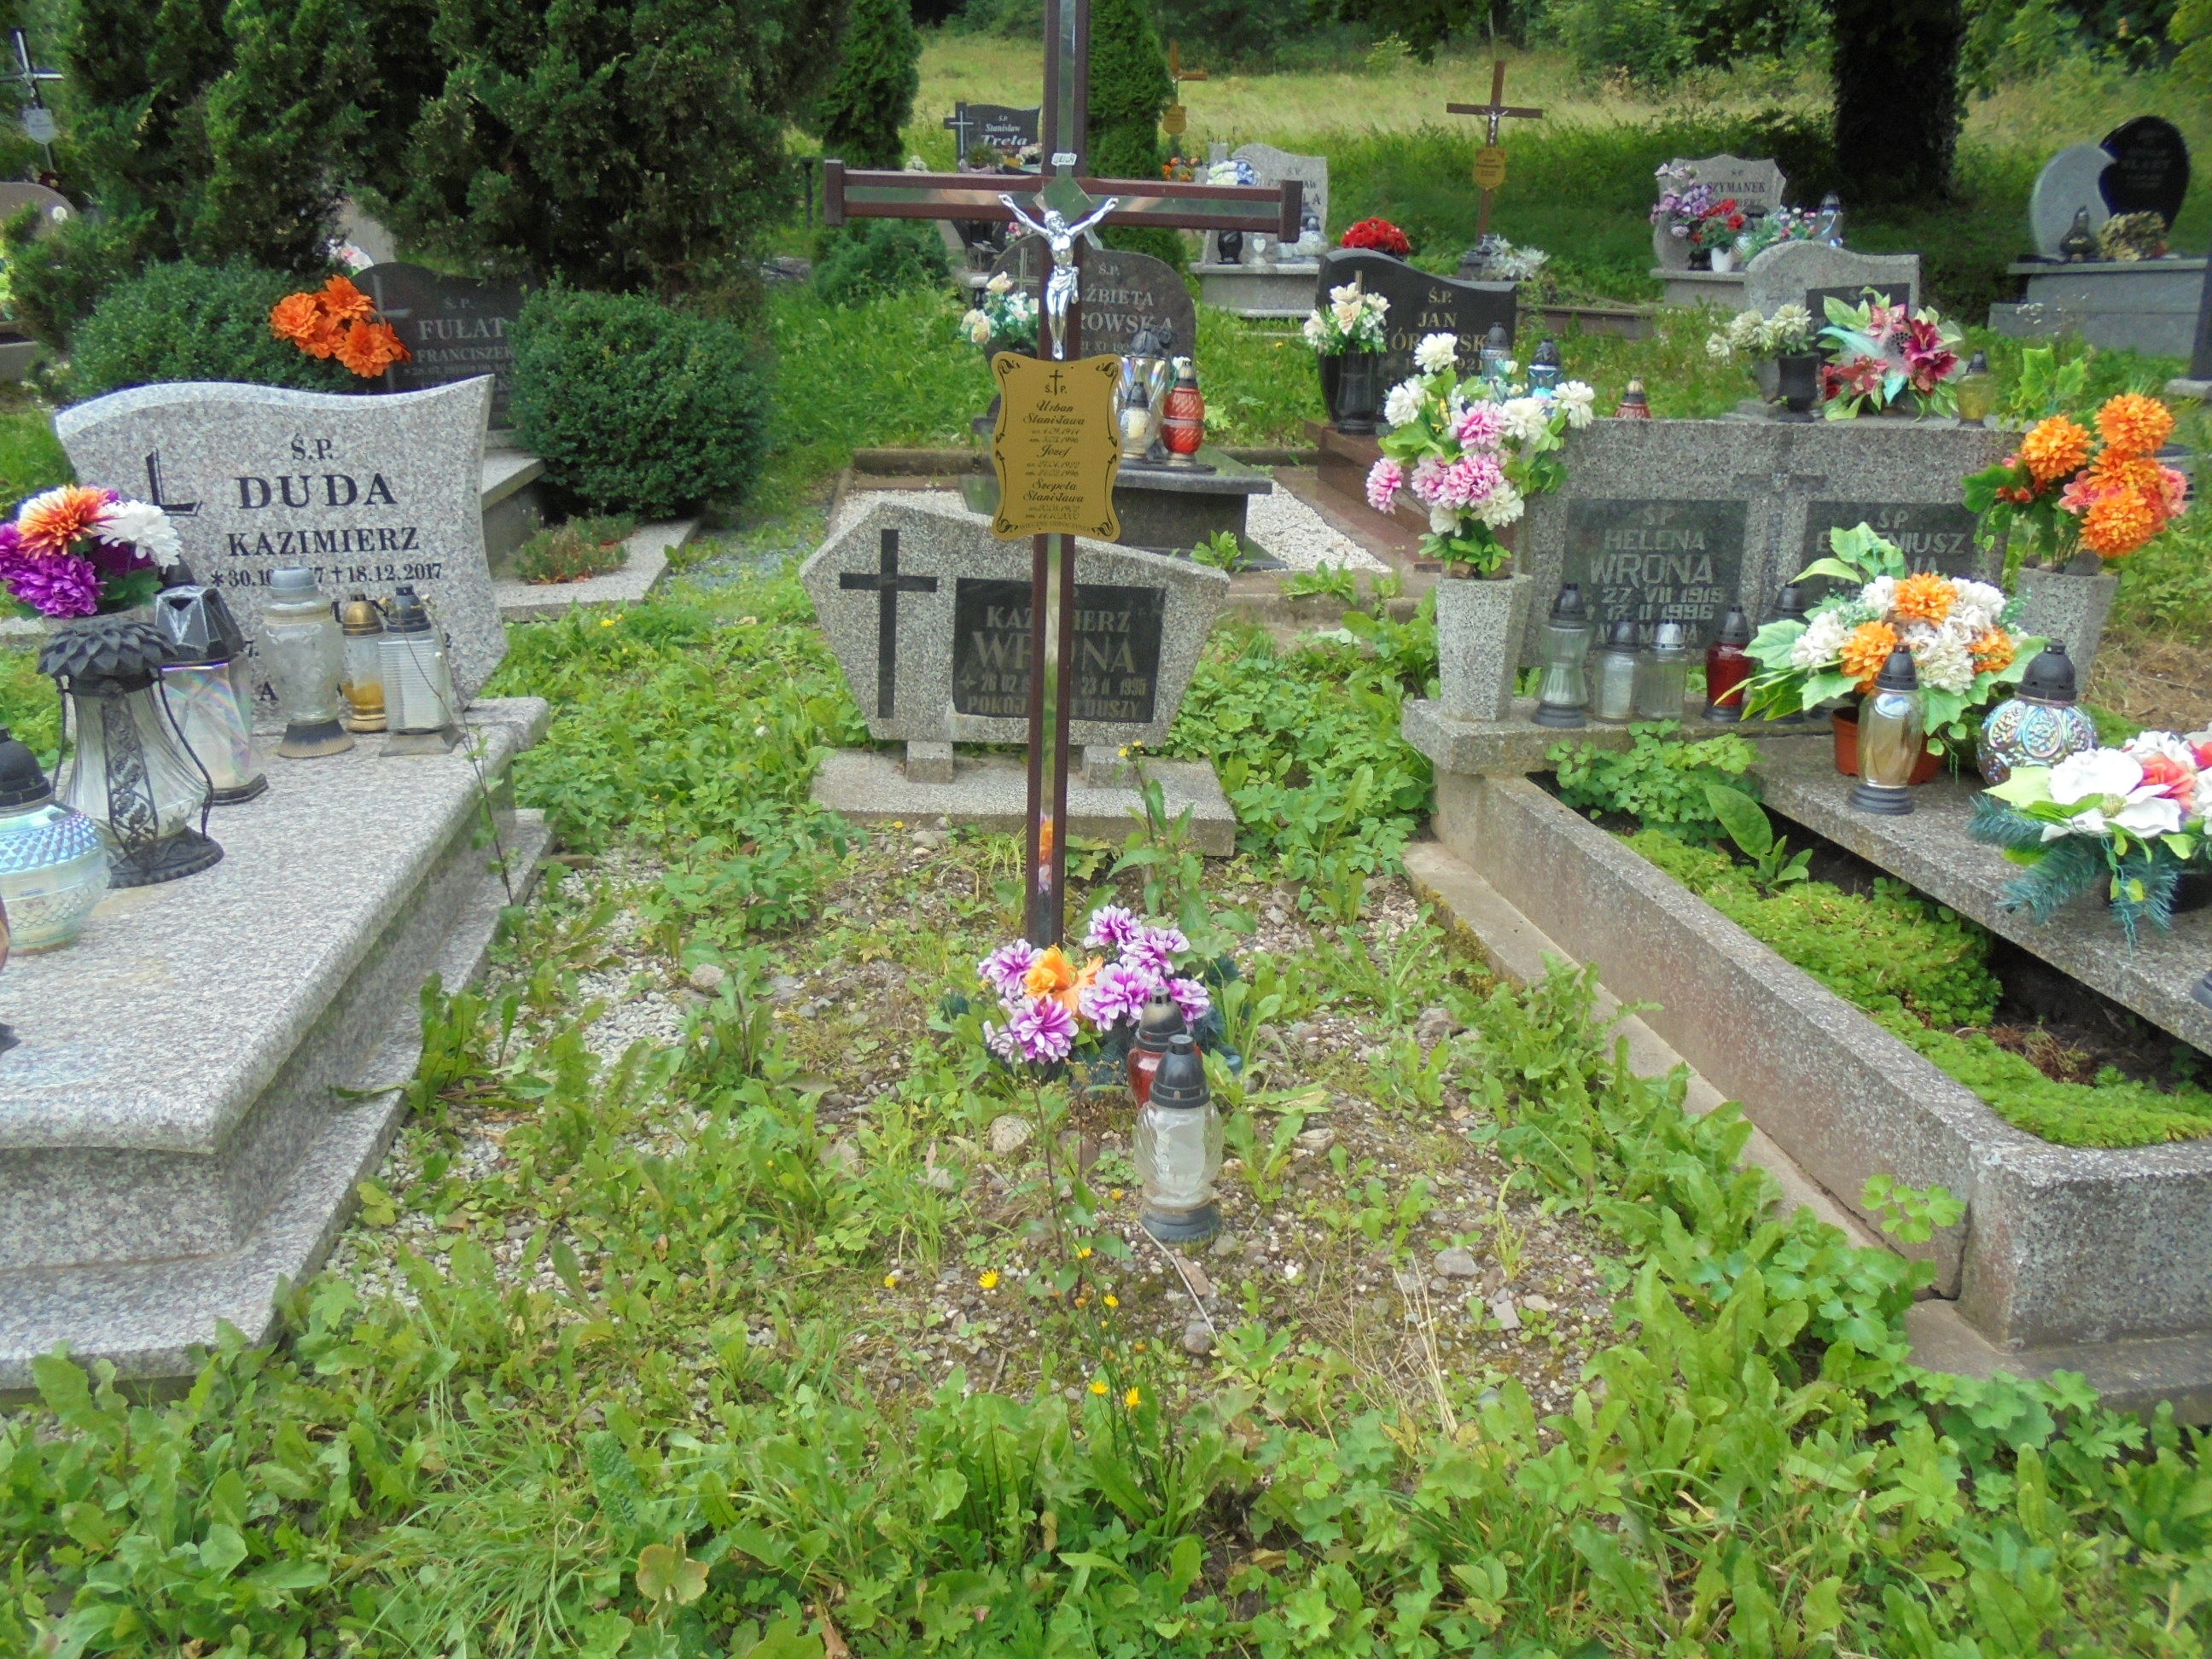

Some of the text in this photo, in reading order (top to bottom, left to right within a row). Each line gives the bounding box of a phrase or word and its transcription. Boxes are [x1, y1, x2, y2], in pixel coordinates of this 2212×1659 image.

[981, 135, 1027, 146] Trela
[1084, 283, 1154, 306] ŻBIETA
[1417, 312, 1458, 328] JAN
[1036, 399, 1074, 412] Urban
[291, 434, 334, 460] Ś.P.
[235, 473, 399, 509] DUDA
[1022, 490, 1084, 503] Stanisława
[225, 527, 420, 556] KAZIMIERZ
[1604, 528, 1706, 550] HELENA
[1817, 533, 1966, 554] ENIUSZ
[346, 563, 442, 584] 18.12.2017
[1590, 553, 1714, 589] WRONA
[987, 605, 1131, 632] KAZIERZ
[968, 696, 1027, 715] POKÓJ
[1085, 698, 1140, 719] DUSZY
